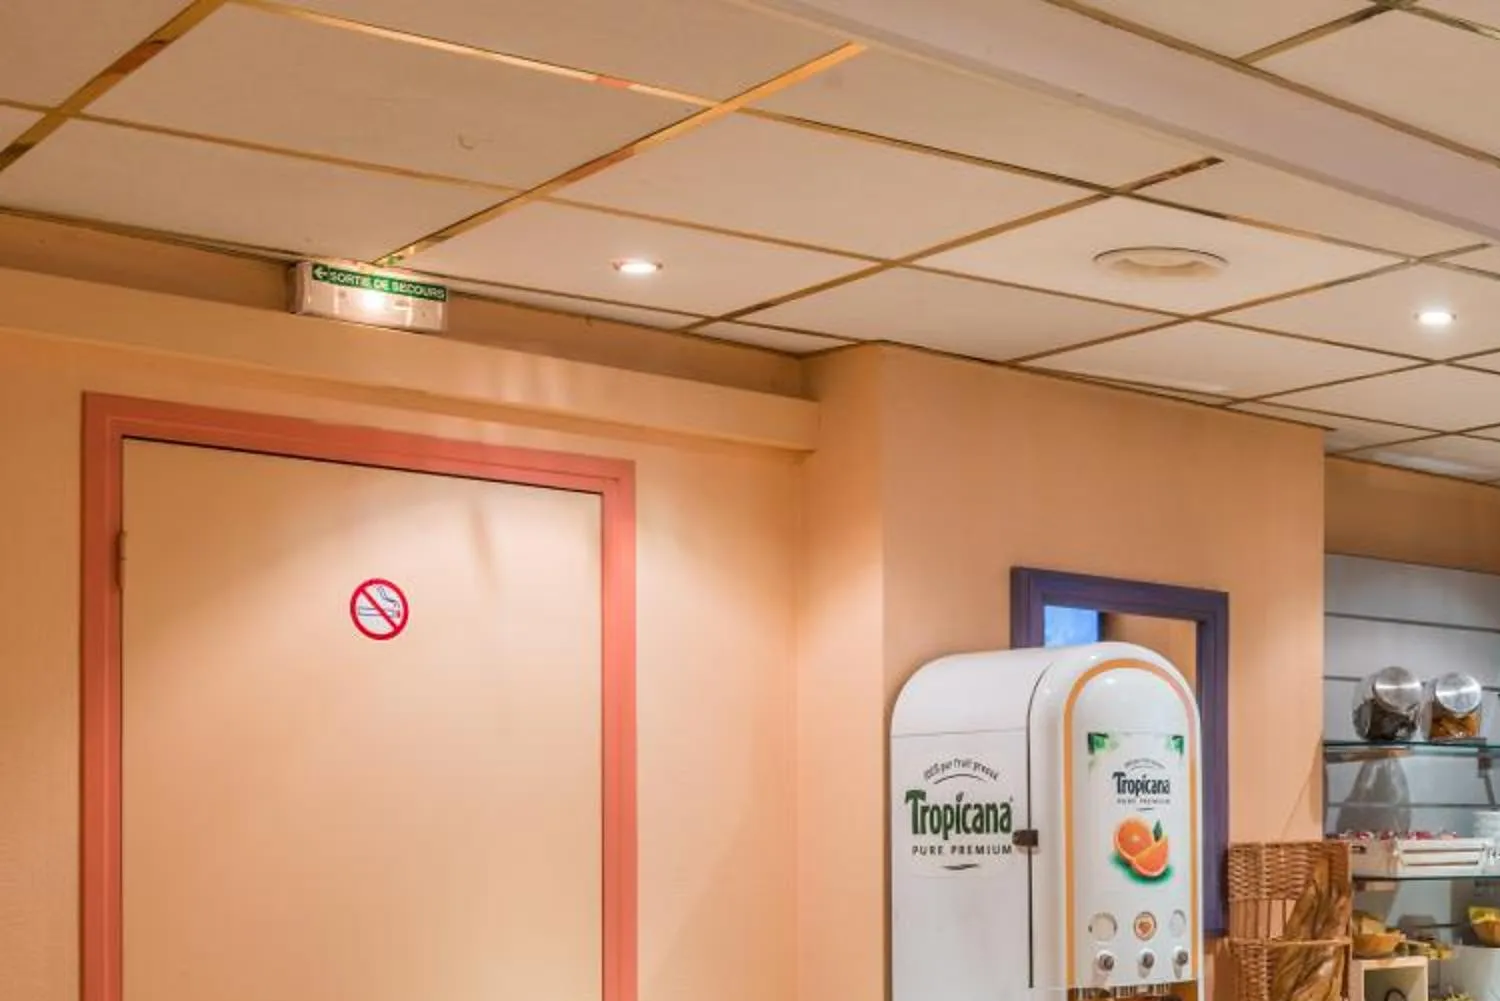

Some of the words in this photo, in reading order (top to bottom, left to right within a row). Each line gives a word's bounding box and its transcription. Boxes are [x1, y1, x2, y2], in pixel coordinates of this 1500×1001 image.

[373, 278, 391, 292] DE
[391, 281, 446, 299] SECOURS
[1111, 771, 1171, 797] Tropicana
[904, 789, 1013, 841] Tropicana
[911, 845, 944, 856] PURE
[950, 845, 1013, 856] PREMIUM
